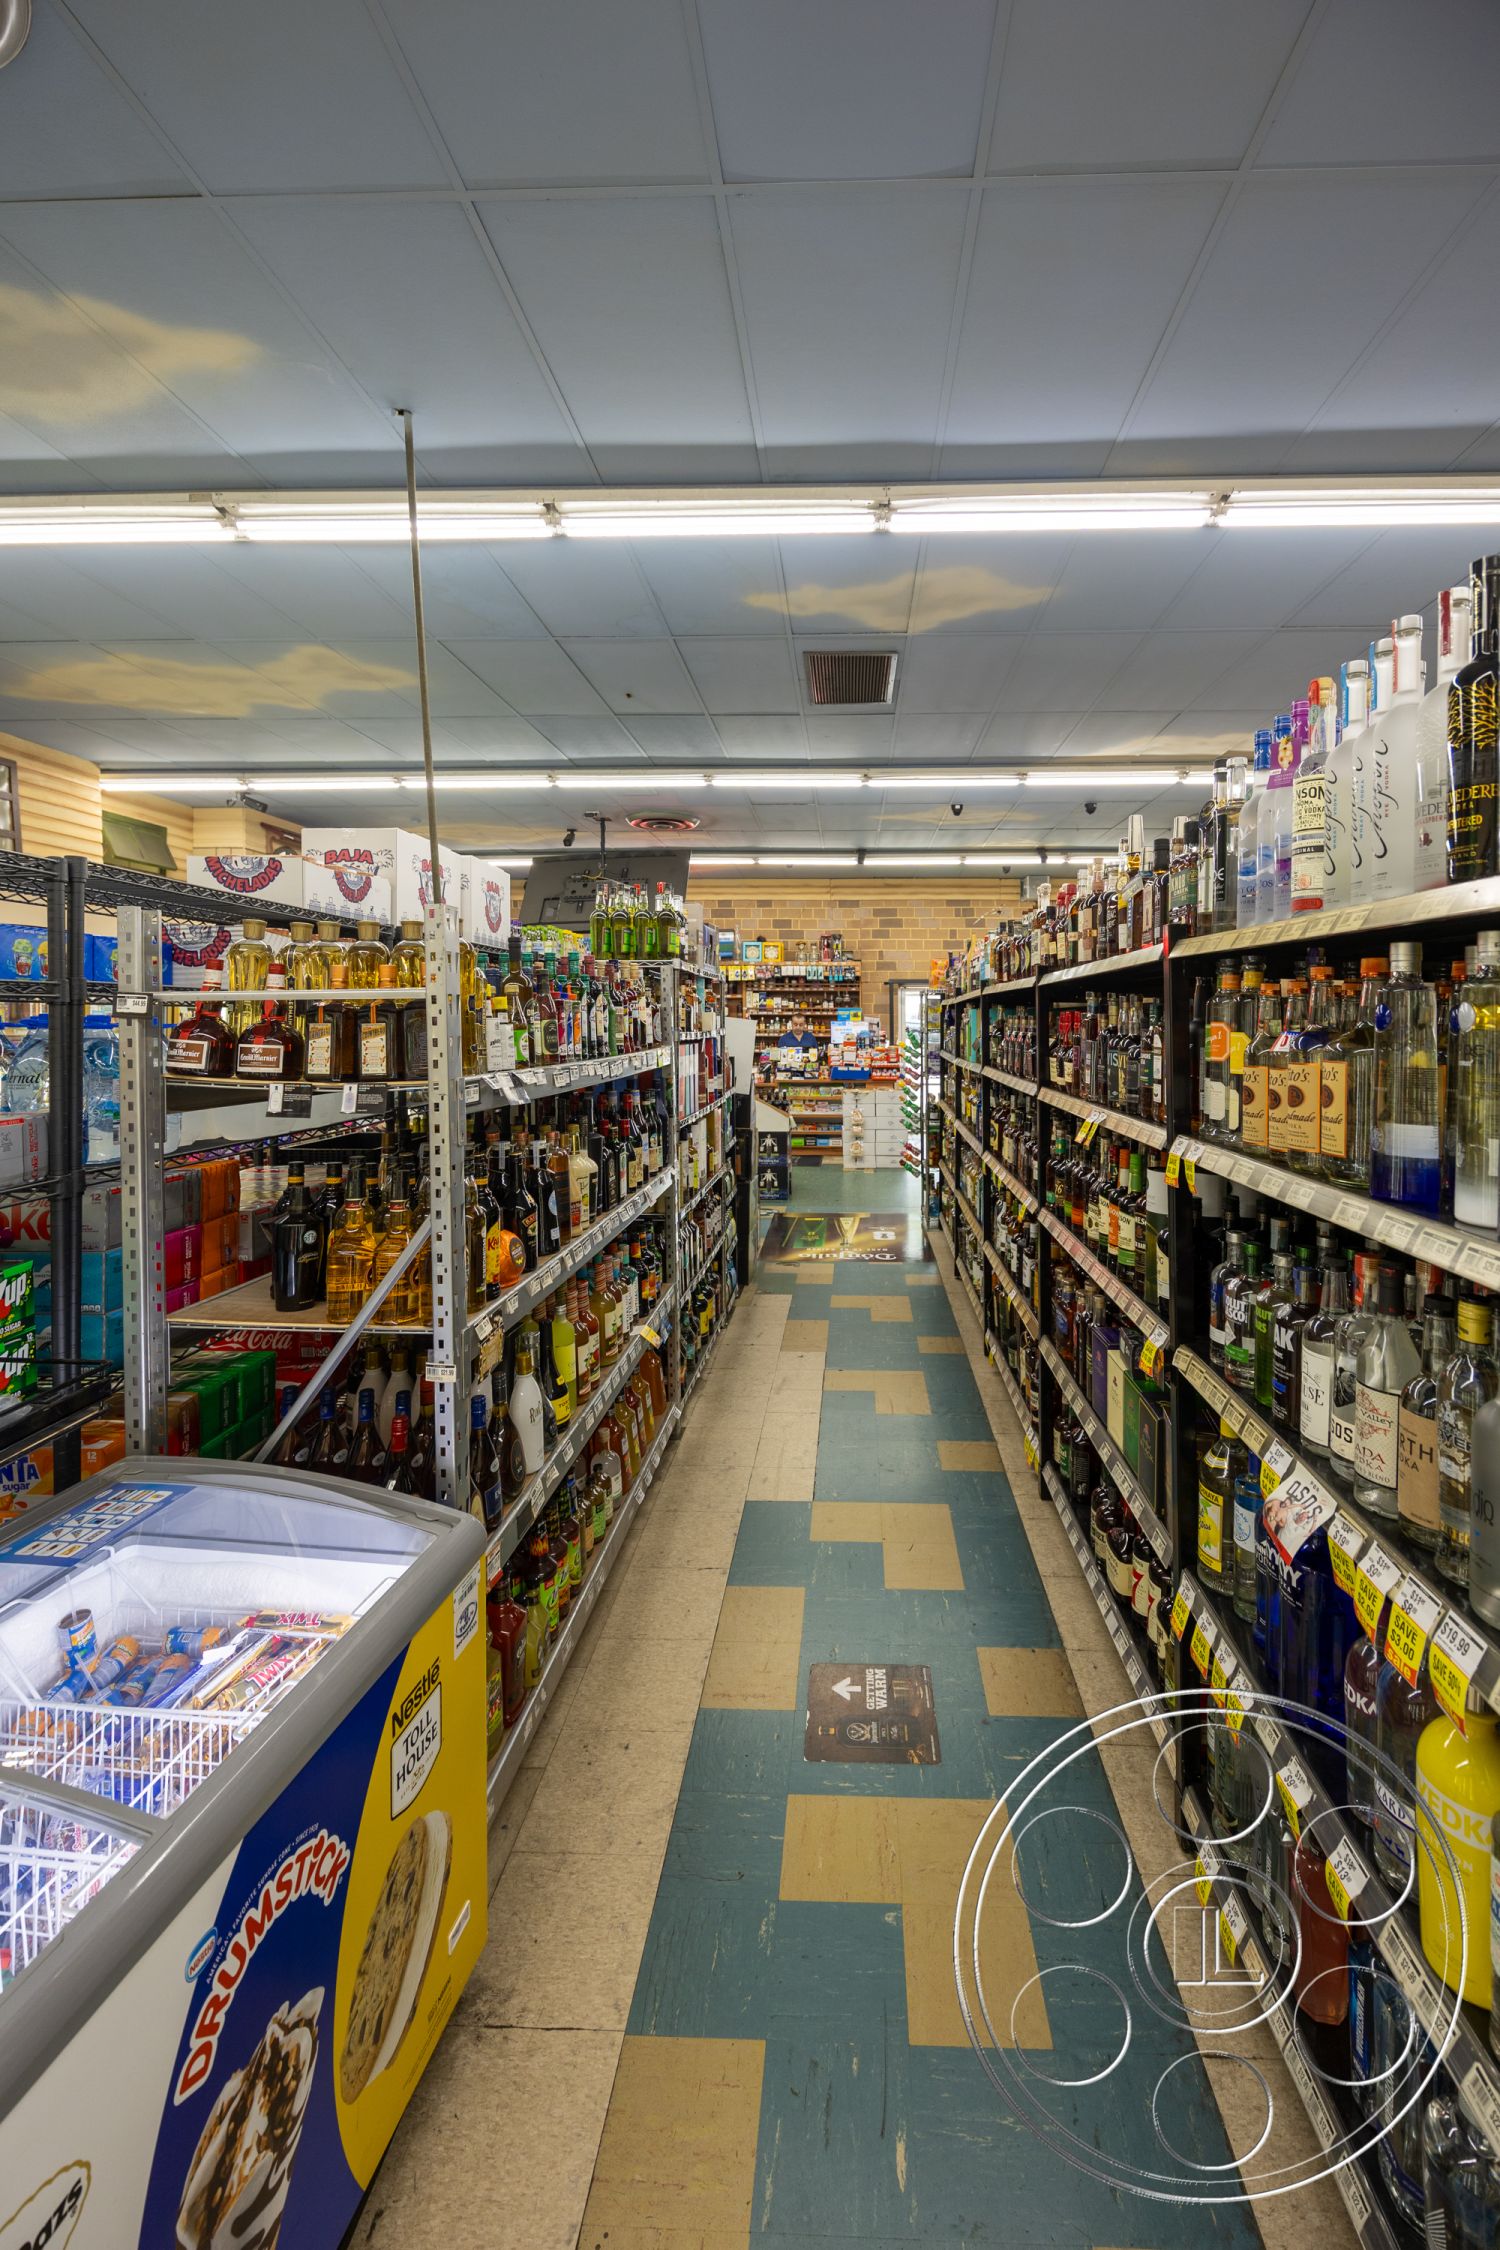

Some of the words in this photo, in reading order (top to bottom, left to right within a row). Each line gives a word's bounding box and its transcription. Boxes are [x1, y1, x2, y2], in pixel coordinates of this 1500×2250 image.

[324, 848, 374, 866] BAJA
[421, 858, 445, 878] BAA
[204, 856, 284, 894] MICHELADAS
[1243, 1070, 1261, 1084] to's
[1269, 1073, 1288, 1087] to's
[90, 1193, 102, 1201] 12
[87, 1451, 97, 1460] 12
[2, 1480, 30, 1493] sugar
[1359, 1579, 1378, 1608] SAVE
[1394, 1614, 1418, 1644] SAVE
[1440, 1621, 1471, 1656] $19.99
[1390, 1630, 1415, 1662] $3.00
[247, 1654, 294, 1688] TWIX
[1387, 1647, 1412, 1680] sale
[1433, 1653, 1448, 1682] SAVE
[391, 1655, 441, 1738] Nestlé
[865, 1668, 875, 1710] GETTING
[875, 1668, 888, 1710] WARM
[402, 1709, 433, 1755] TOLL
[396, 1719, 438, 1792] HOUSE
[206, 1930, 234, 1985] AMERICA'S
[232, 1889, 258, 1930] FAVORITE
[257, 1859, 279, 1889] SUNDAE
[178, 1833, 349, 2097] DRUMSTICK
[1350, 2190, 1365, 2220] $22.99
